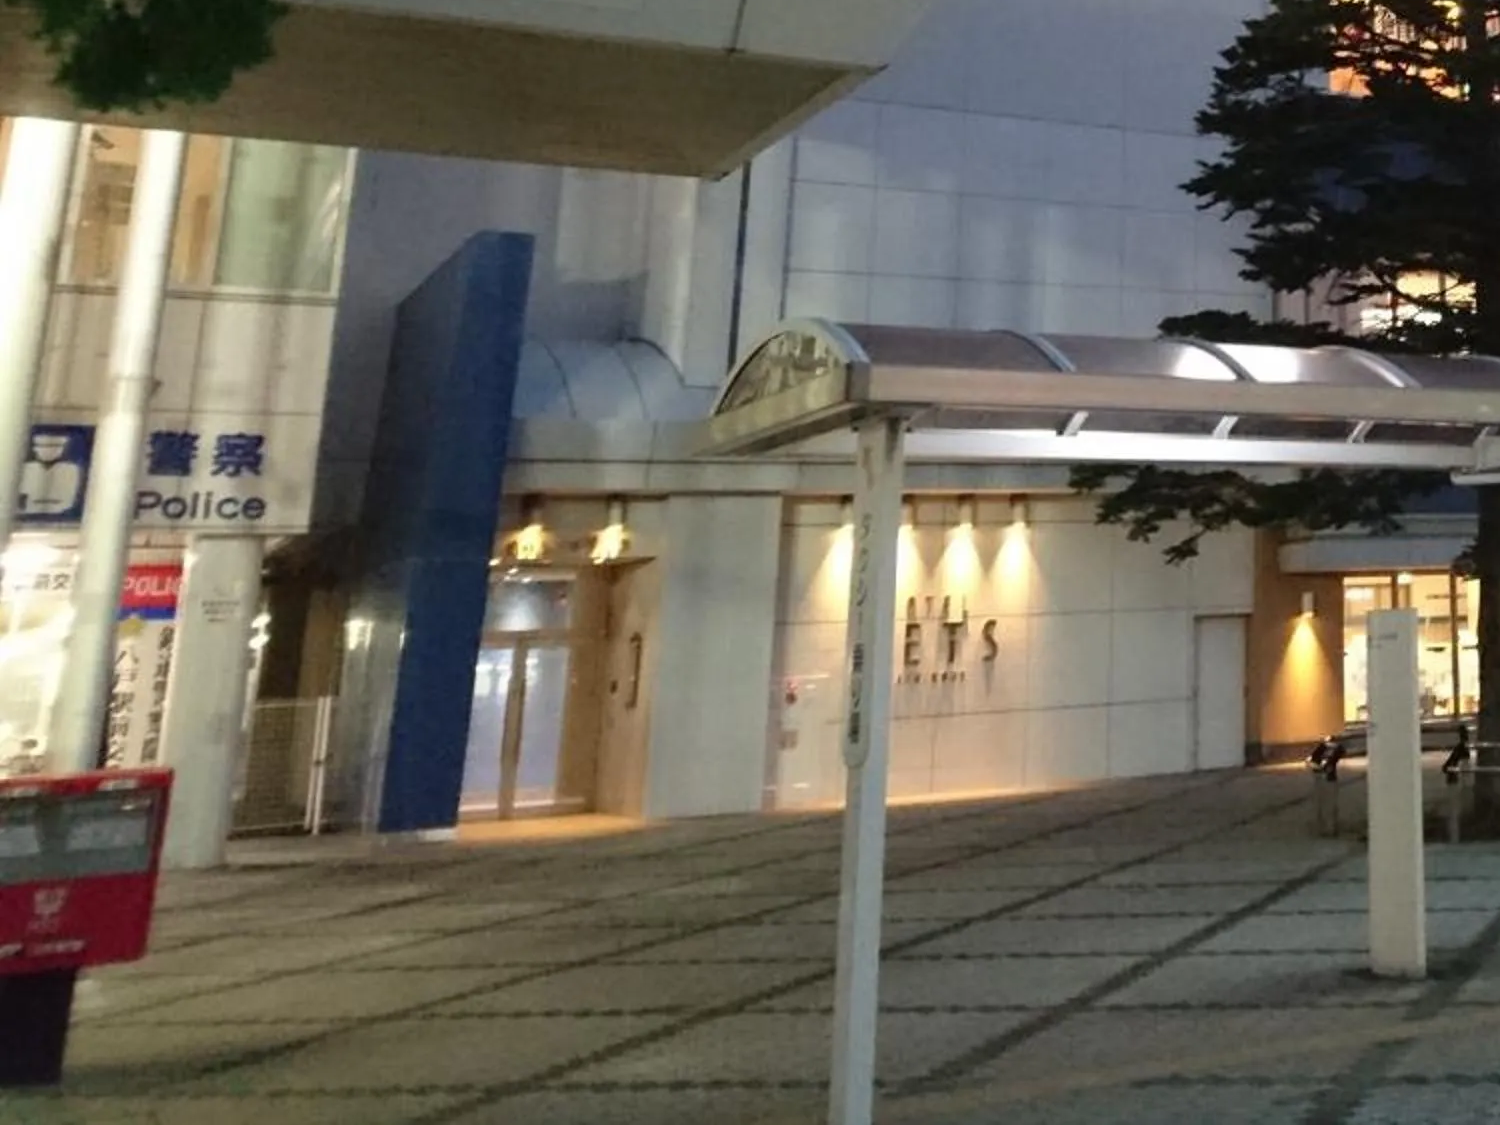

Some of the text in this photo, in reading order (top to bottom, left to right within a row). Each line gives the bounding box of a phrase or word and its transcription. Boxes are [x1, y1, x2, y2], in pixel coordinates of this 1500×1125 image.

[146, 430, 265, 477] 警察
[133, 490, 266, 520] Police
[904, 618, 999, 667] ETS
